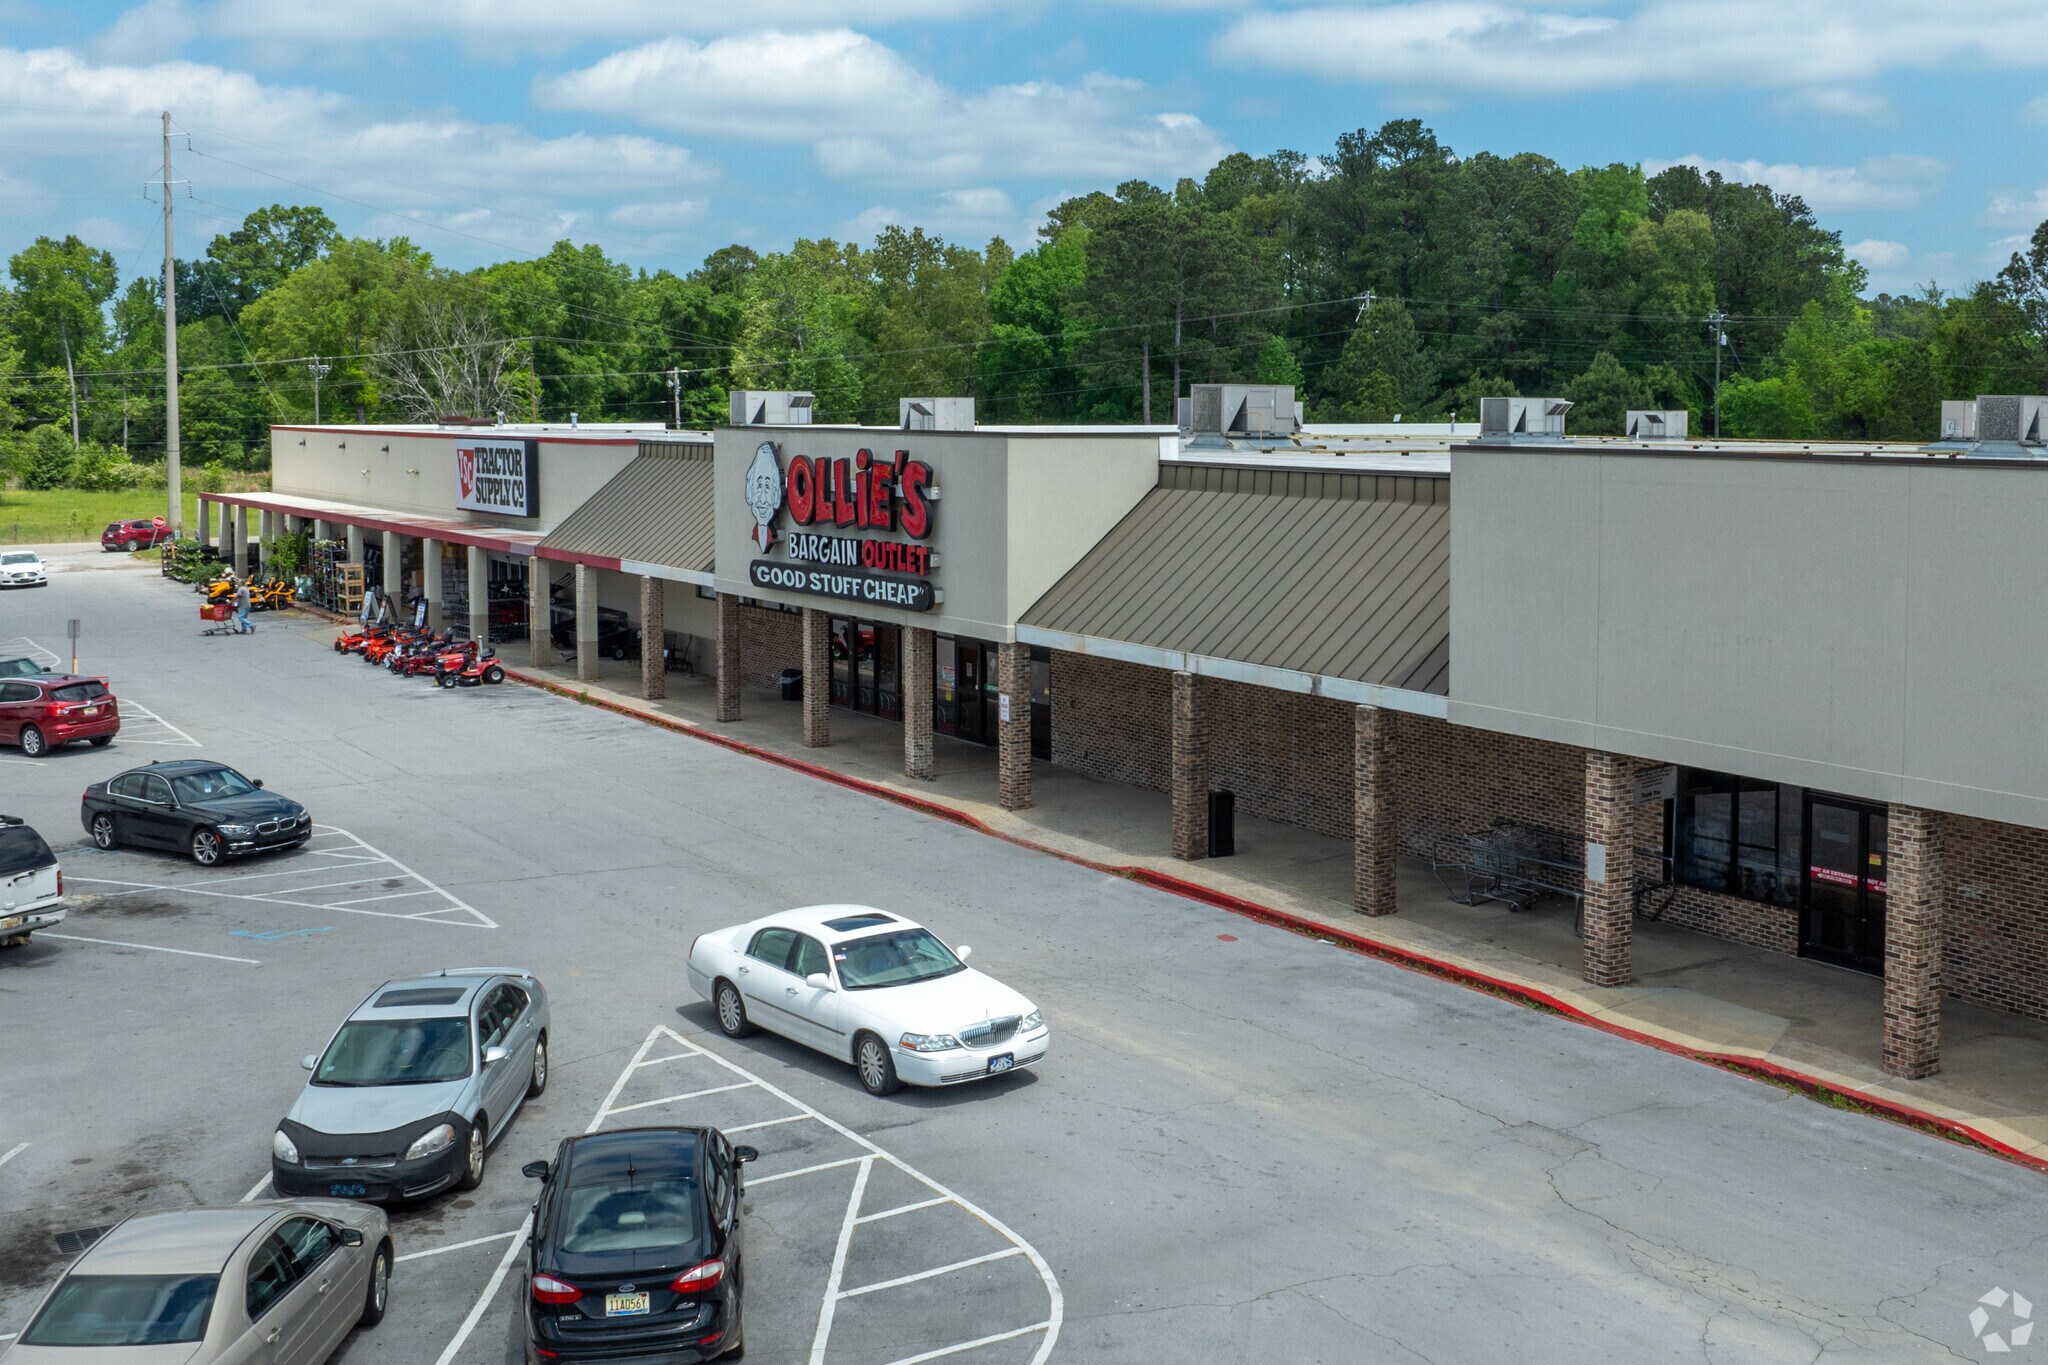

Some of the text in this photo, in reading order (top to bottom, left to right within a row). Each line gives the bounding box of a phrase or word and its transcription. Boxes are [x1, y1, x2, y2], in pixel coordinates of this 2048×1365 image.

[458, 450, 473, 490] TSC
[474, 447, 523, 477] TRACTOR
[475, 476, 511, 506] SUPPLY
[788, 533, 931, 575] BARGAIN OUTLET
[810, 573, 862, 597] STUFF
[1831, 870, 1858, 880] ENTRANCE
